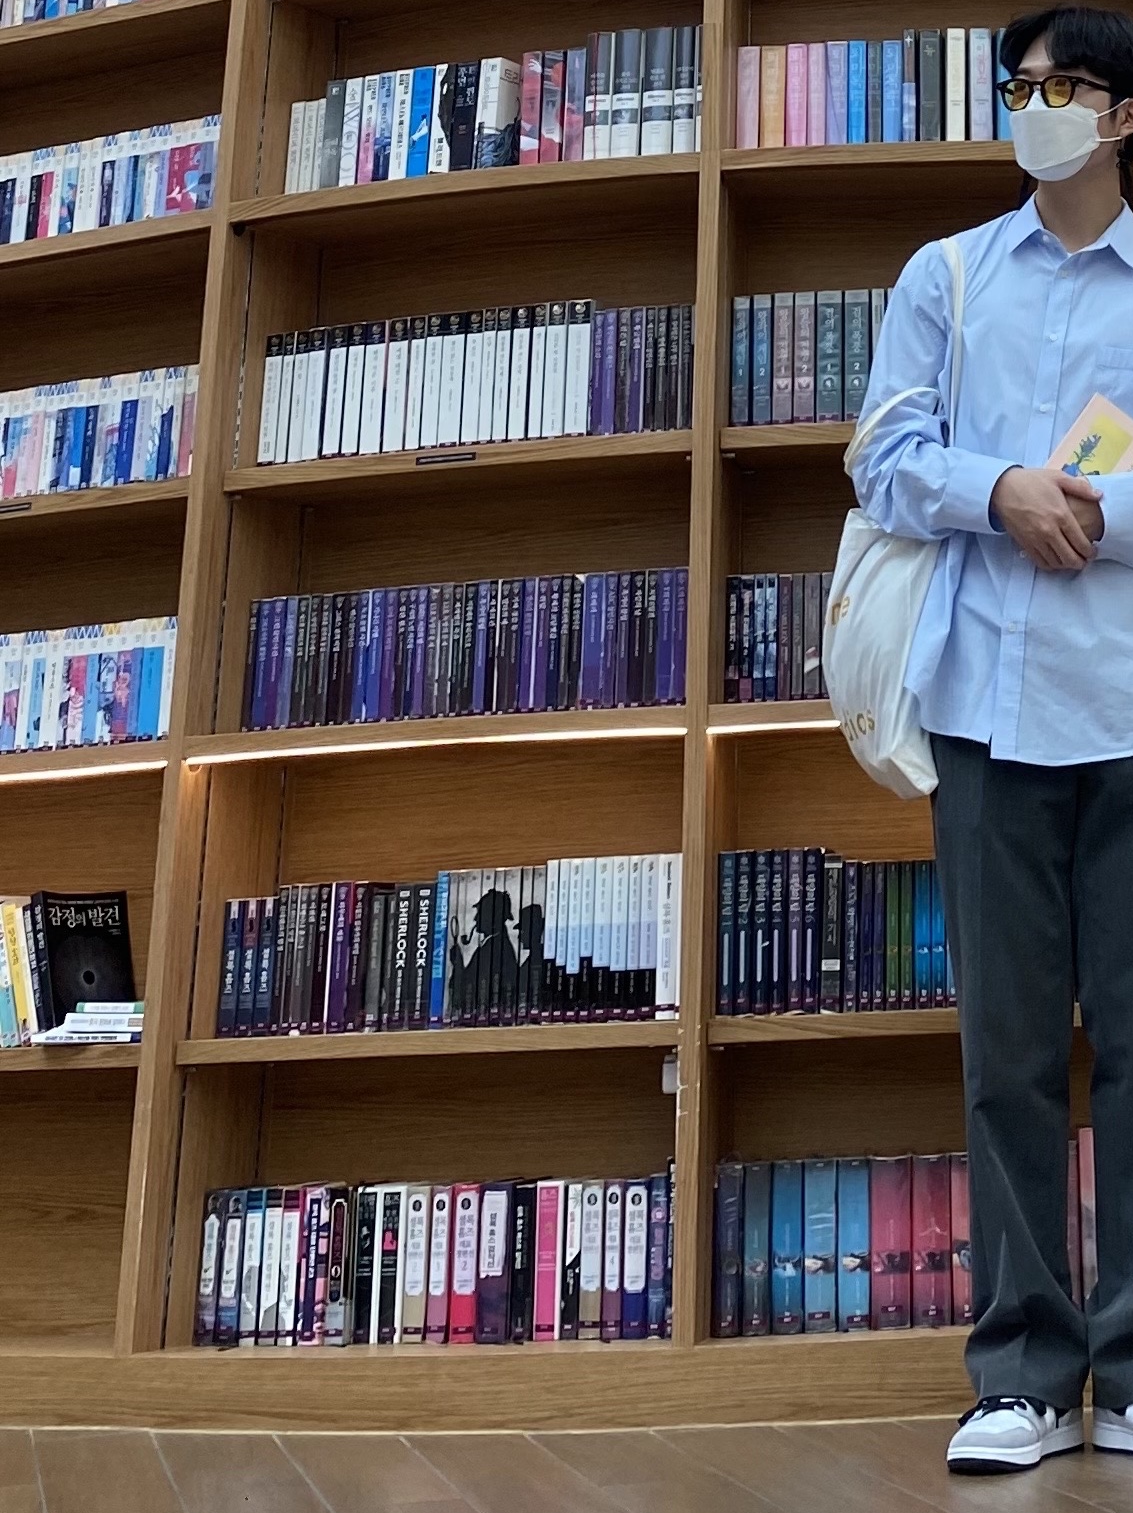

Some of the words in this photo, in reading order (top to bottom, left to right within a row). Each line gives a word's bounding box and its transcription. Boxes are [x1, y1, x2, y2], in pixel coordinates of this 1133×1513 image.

[759, 368, 765, 376] 2
[801, 365, 808, 373] 2
[854, 362, 860, 370] 2
[48, 906, 86, 928] 감정의
[88, 906, 121, 927] 발견
[395, 900, 409, 968] SHERLOCK
[415, 899, 429, 967] SHERLOCK
